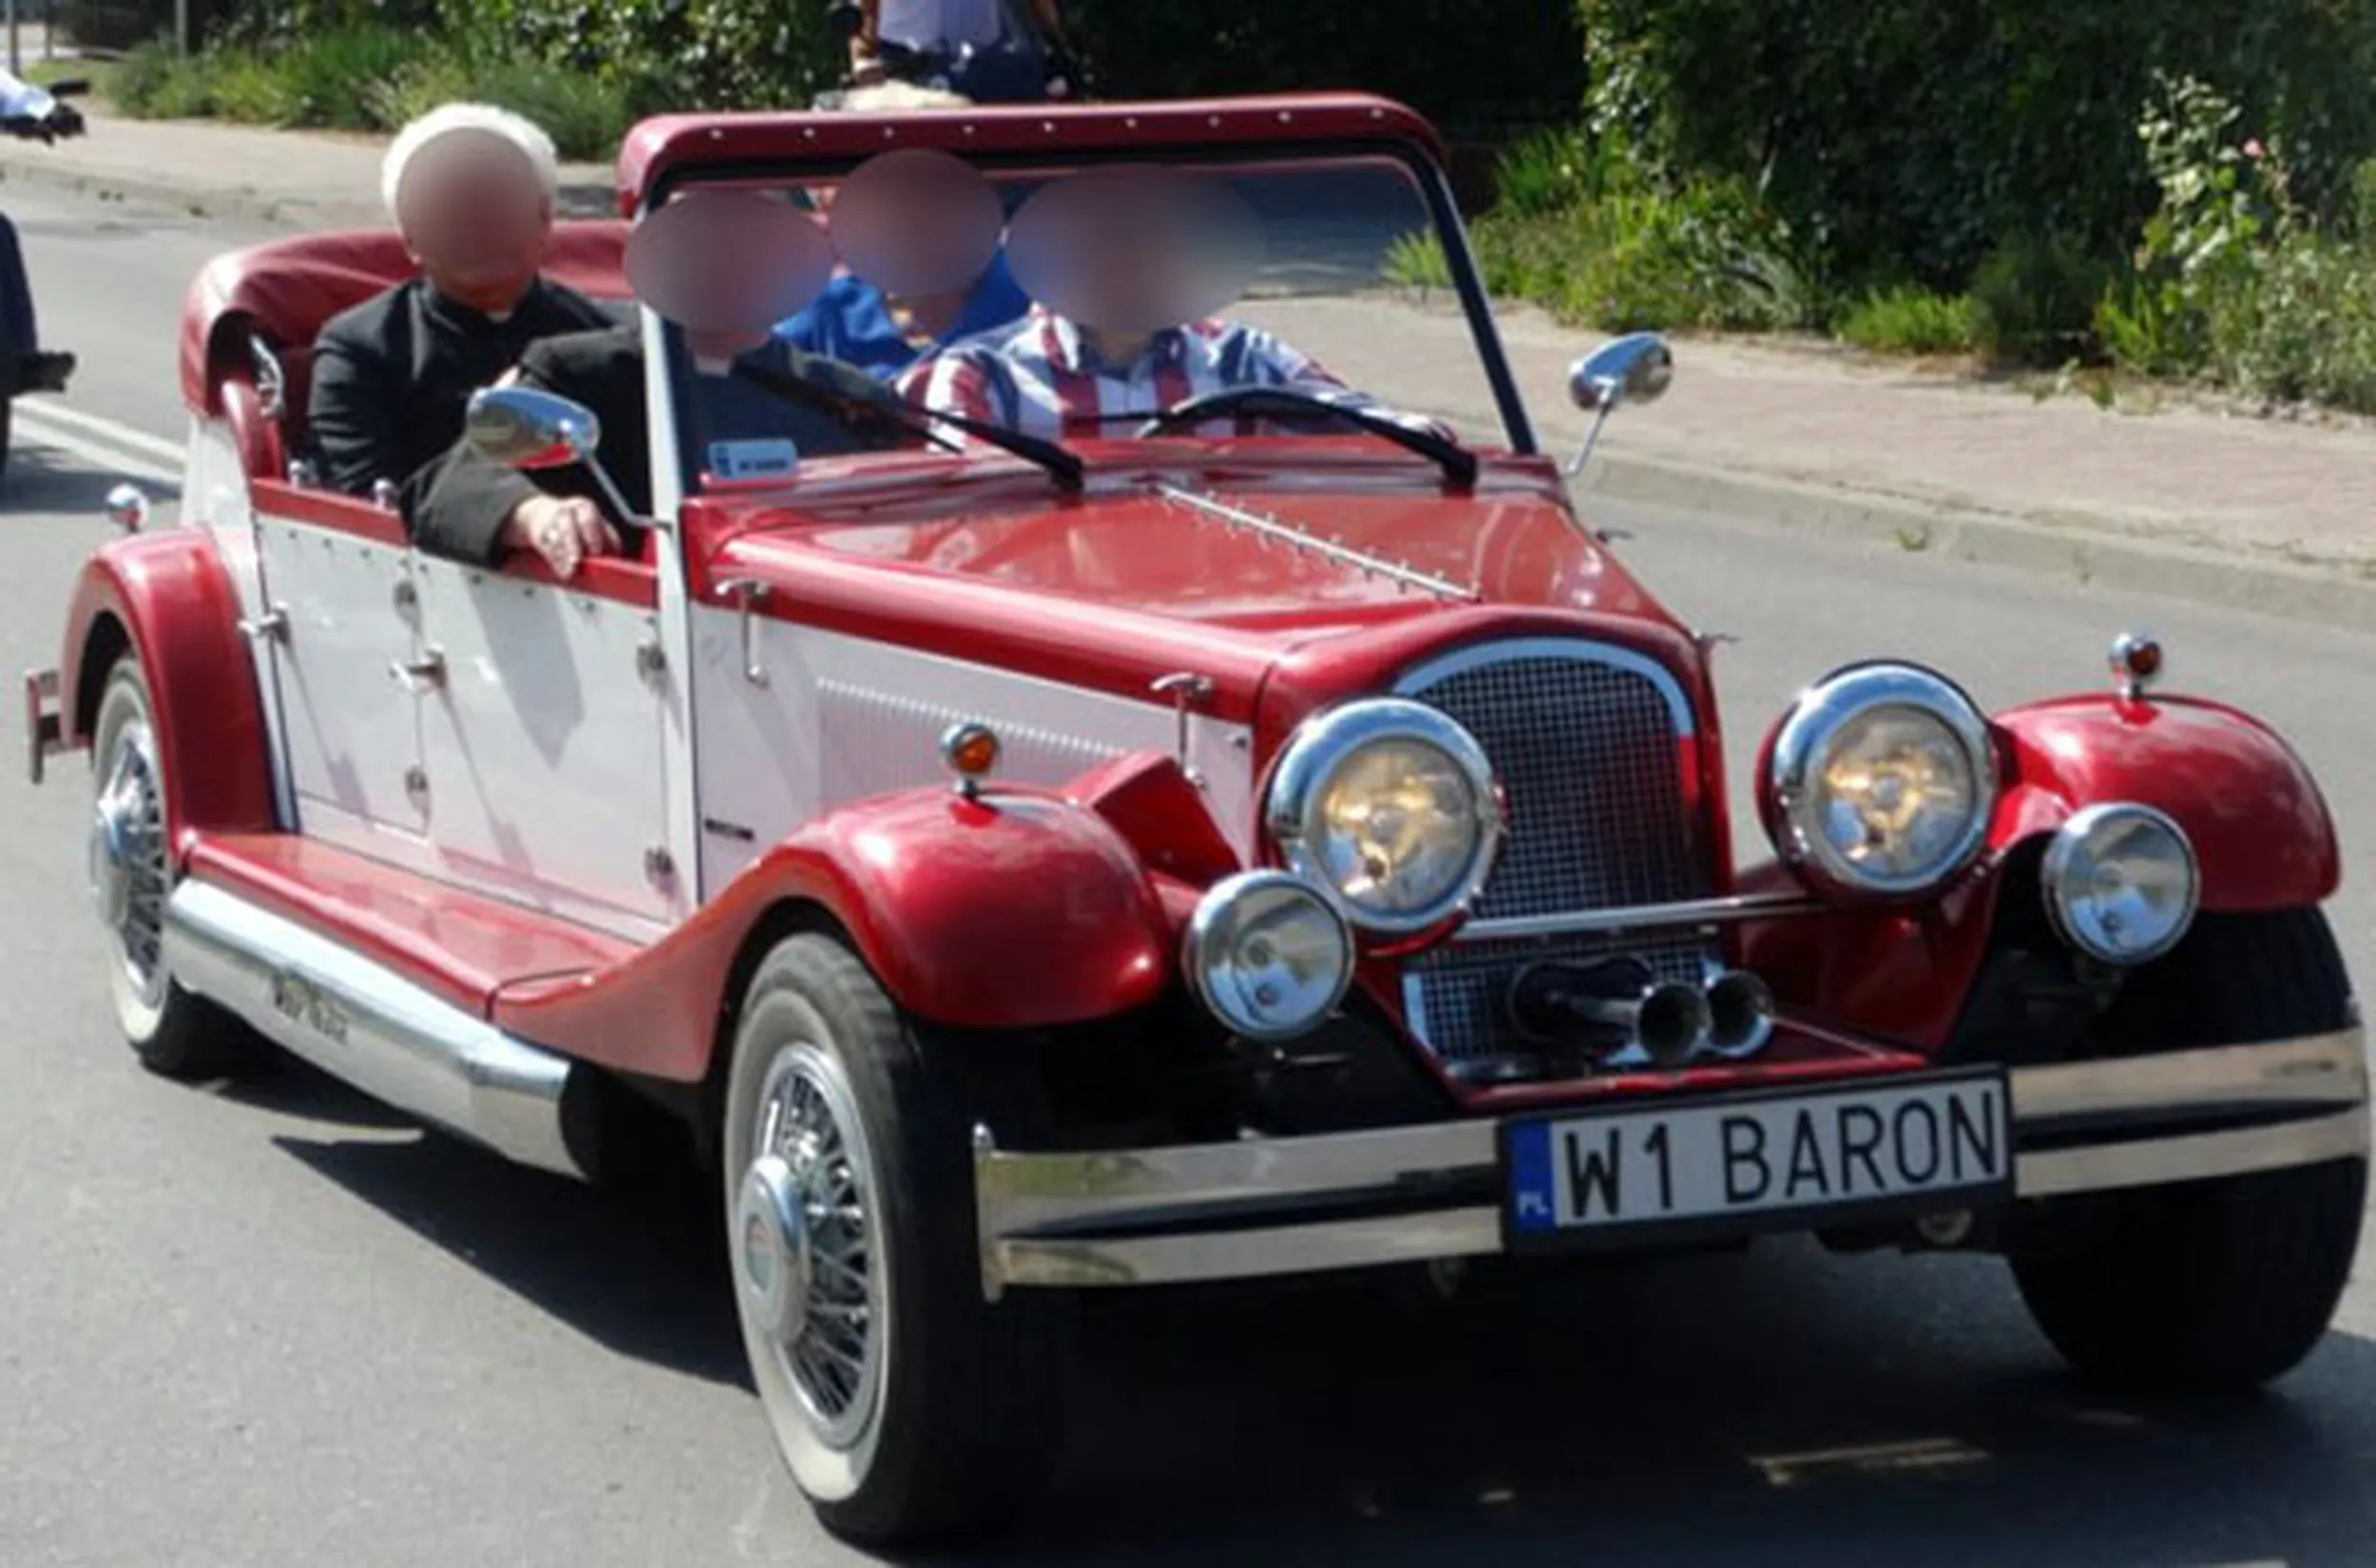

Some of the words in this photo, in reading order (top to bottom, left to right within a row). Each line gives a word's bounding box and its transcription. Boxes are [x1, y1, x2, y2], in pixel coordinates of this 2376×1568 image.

[1564, 1122, 1674, 1219] W1
[1720, 1089, 1997, 1206] BARON
[1517, 1192, 1550, 1216] PL
